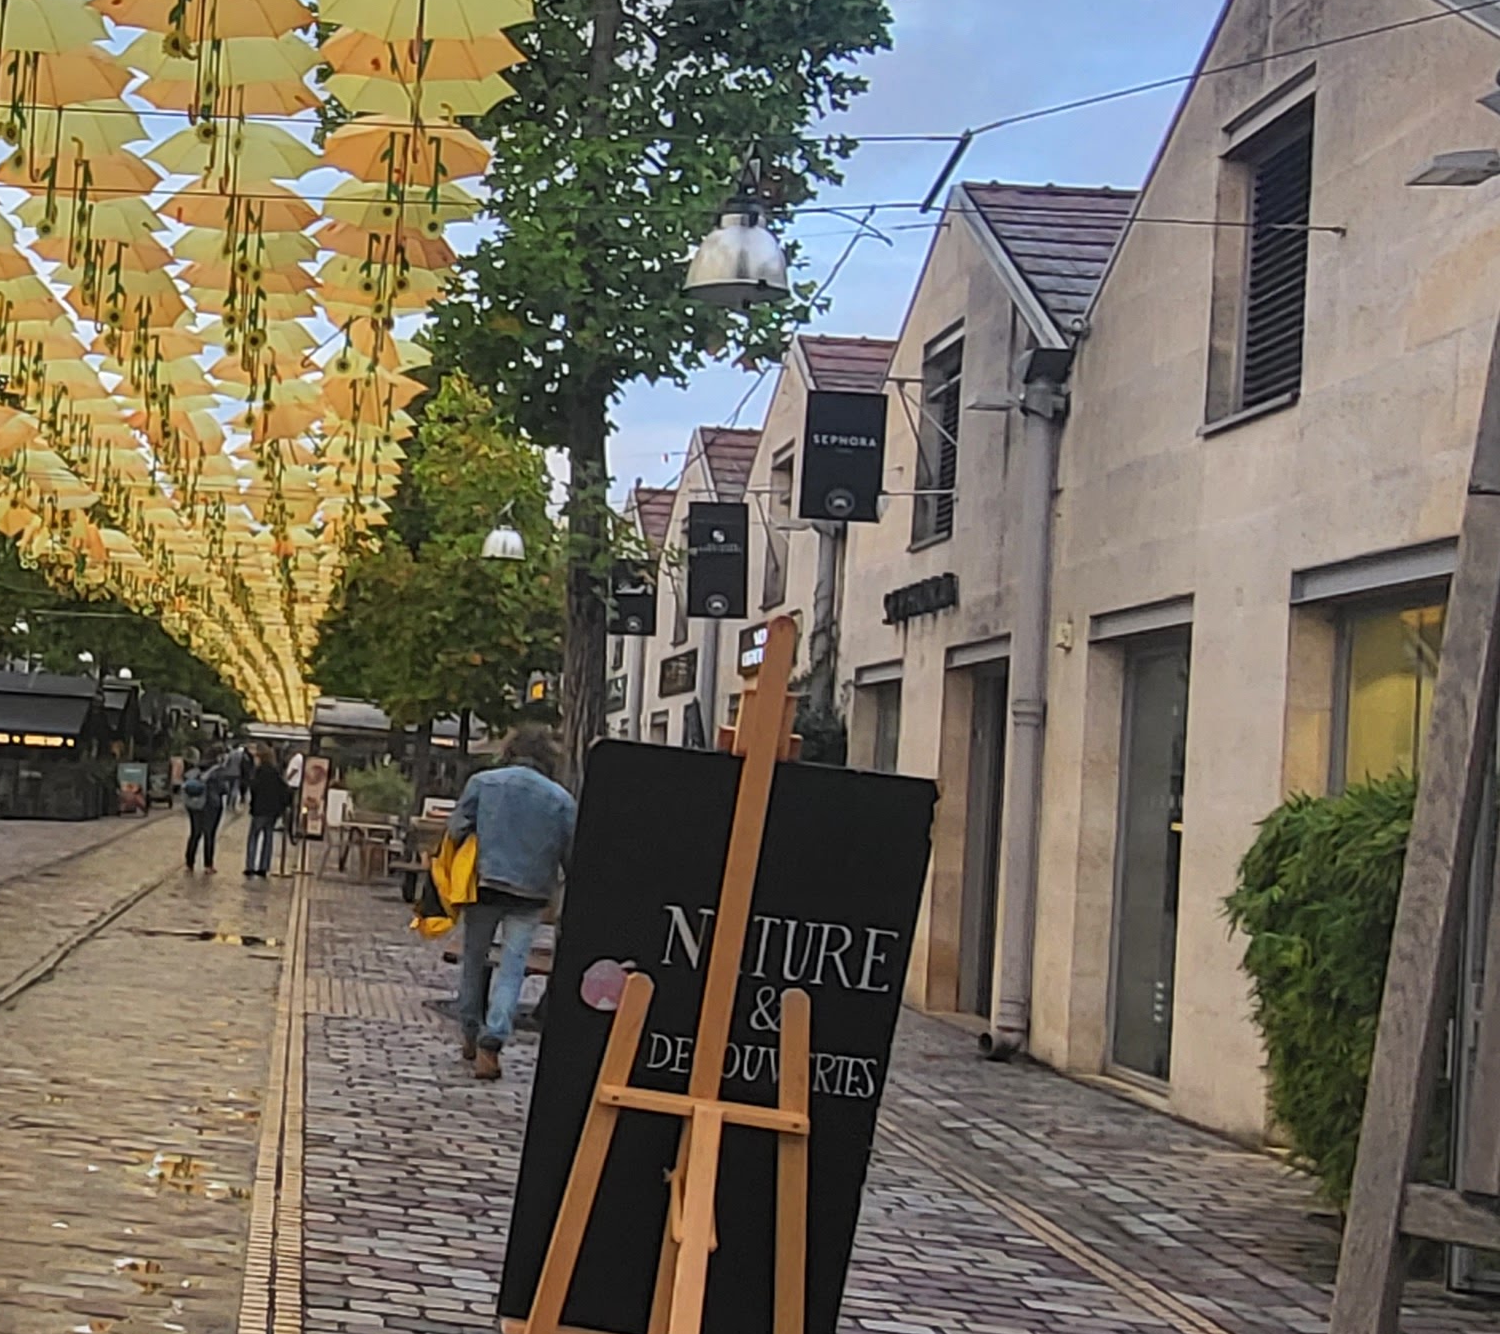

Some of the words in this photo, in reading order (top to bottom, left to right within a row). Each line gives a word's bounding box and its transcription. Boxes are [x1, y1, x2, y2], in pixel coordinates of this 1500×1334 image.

[812, 434, 878, 448] SEPHORA
[660, 904, 899, 992] NTURE
[749, 985, 782, 1032] &
[646, 1032, 878, 1099] DEOUVRTES
